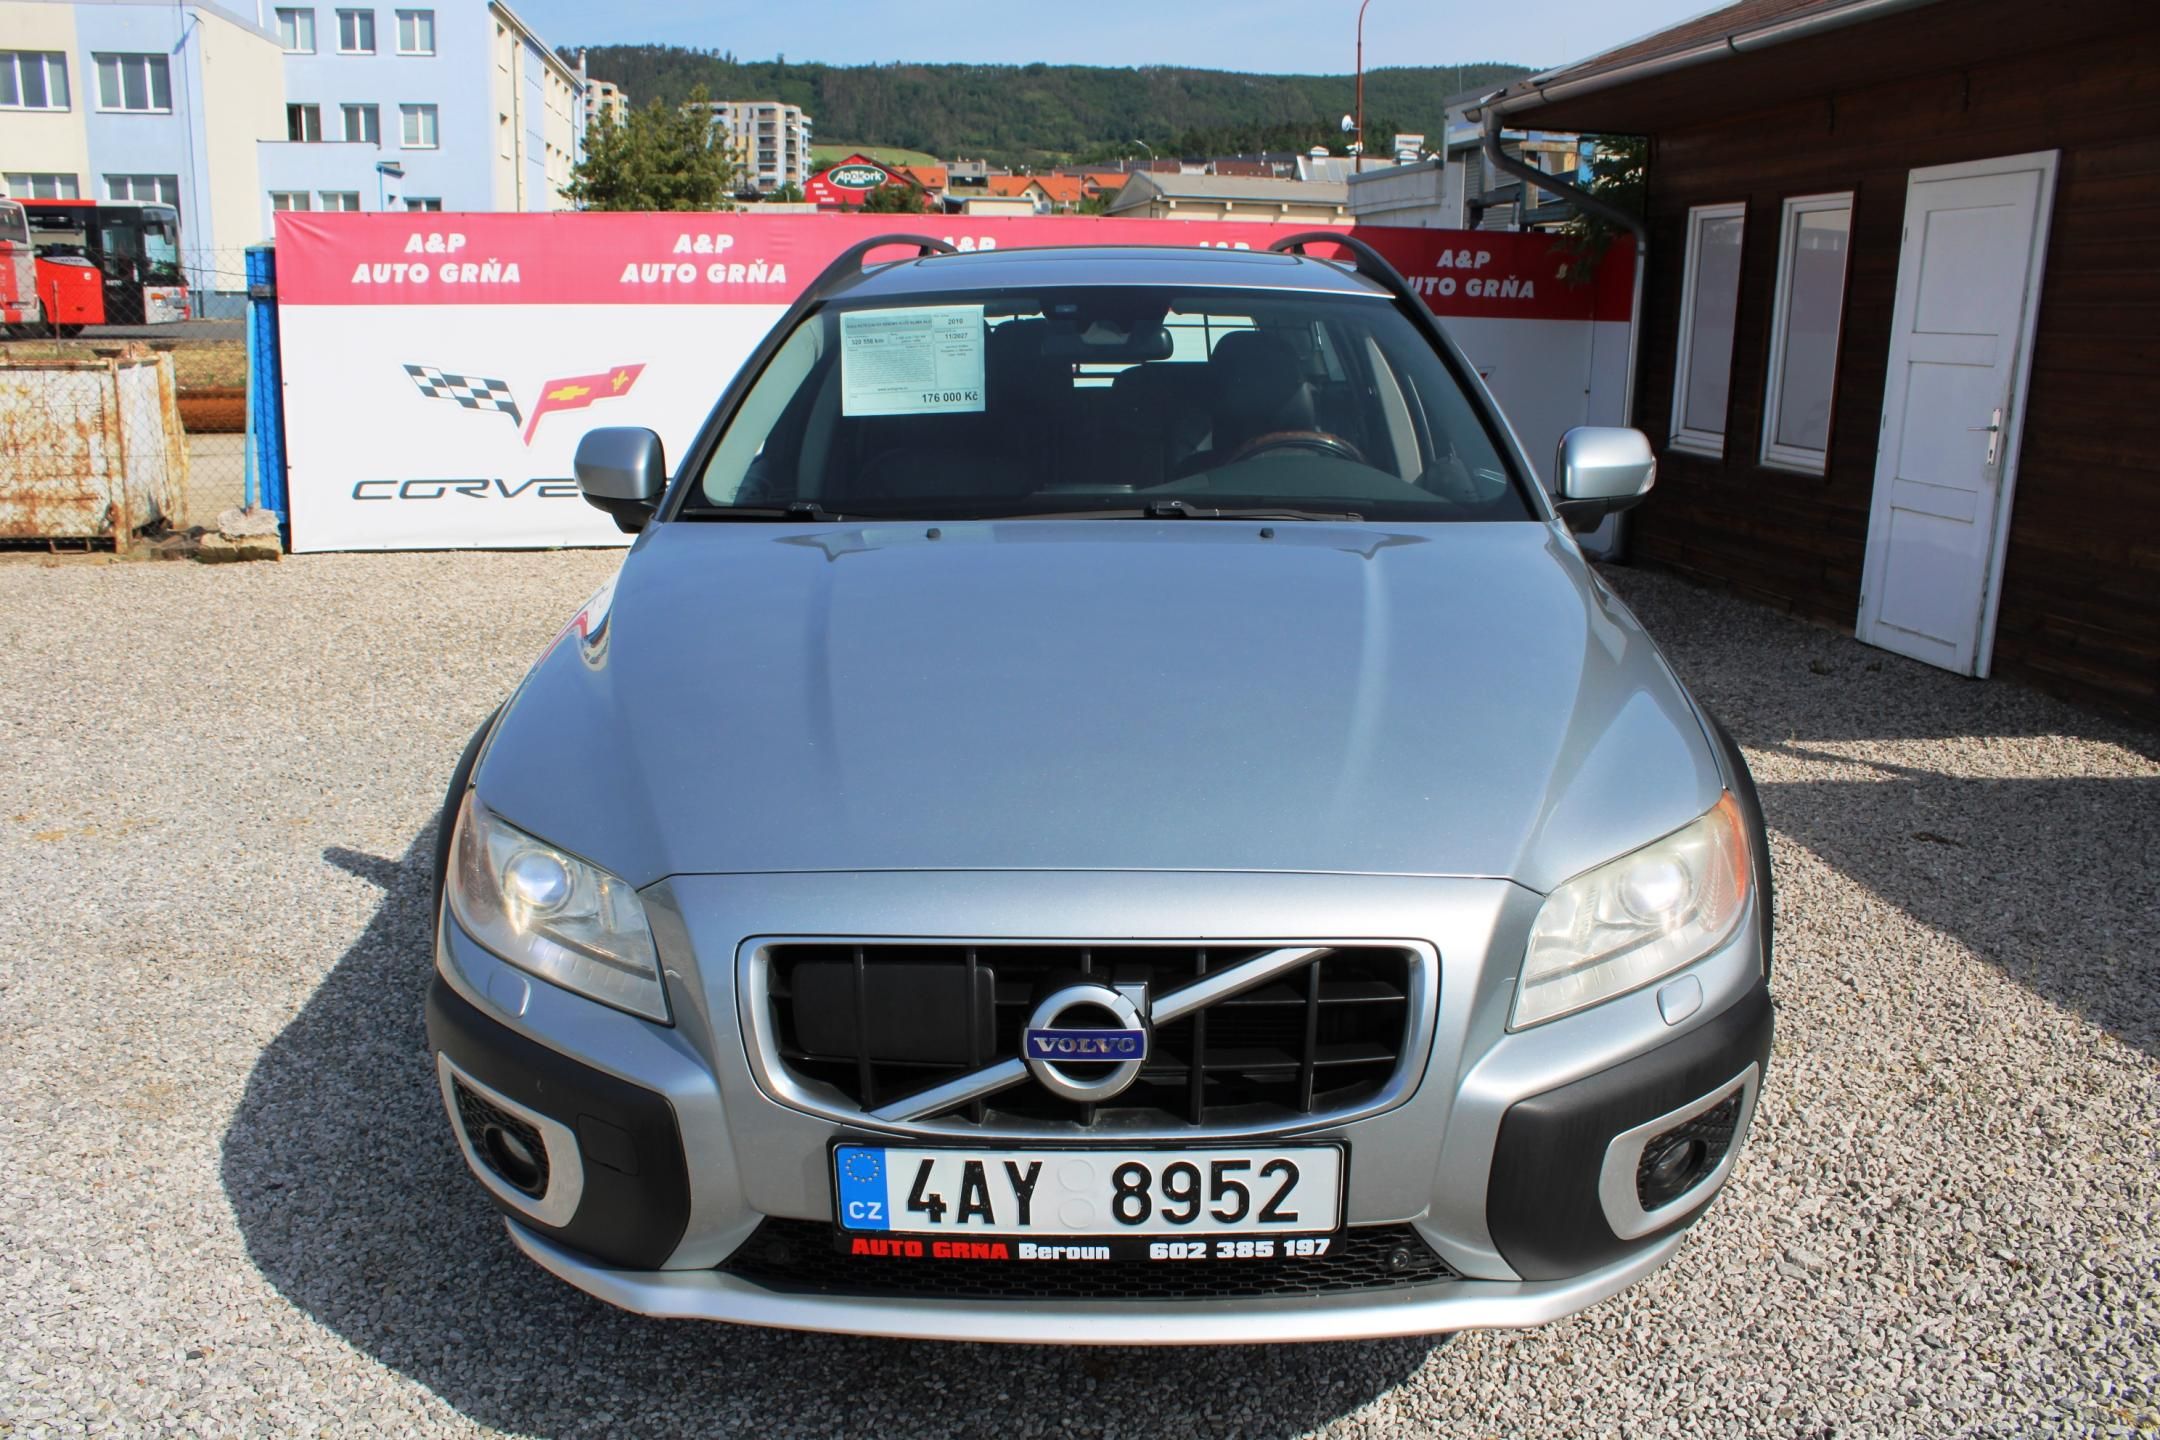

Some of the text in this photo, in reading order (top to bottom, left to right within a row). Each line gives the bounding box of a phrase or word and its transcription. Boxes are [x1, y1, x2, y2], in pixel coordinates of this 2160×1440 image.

[404, 233, 466, 253] A&P
[673, 234, 734, 254] A&P
[1437, 249, 1491, 269] A&P
[351, 257, 520, 284] AUTO GRŇA
[620, 258, 786, 283] AUTO GRŇA
[1408, 275, 1535, 298] UTO GRŇA
[922, 391, 978, 403] 176 000 Kč
[351, 478, 579, 500] CORVE
[1033, 1037, 1136, 1054] VOLVO
[907, 1158, 1300, 1225] 4AY 8952
[849, 1202, 882, 1220] CZ
[852, 1238, 923, 1257] AUTO
[1018, 1243, 1110, 1260] Beroun
[1150, 1242, 1207, 1259] 602
[1216, 1240, 1275, 1258] 385
[1283, 1238, 1330, 1256] 197
